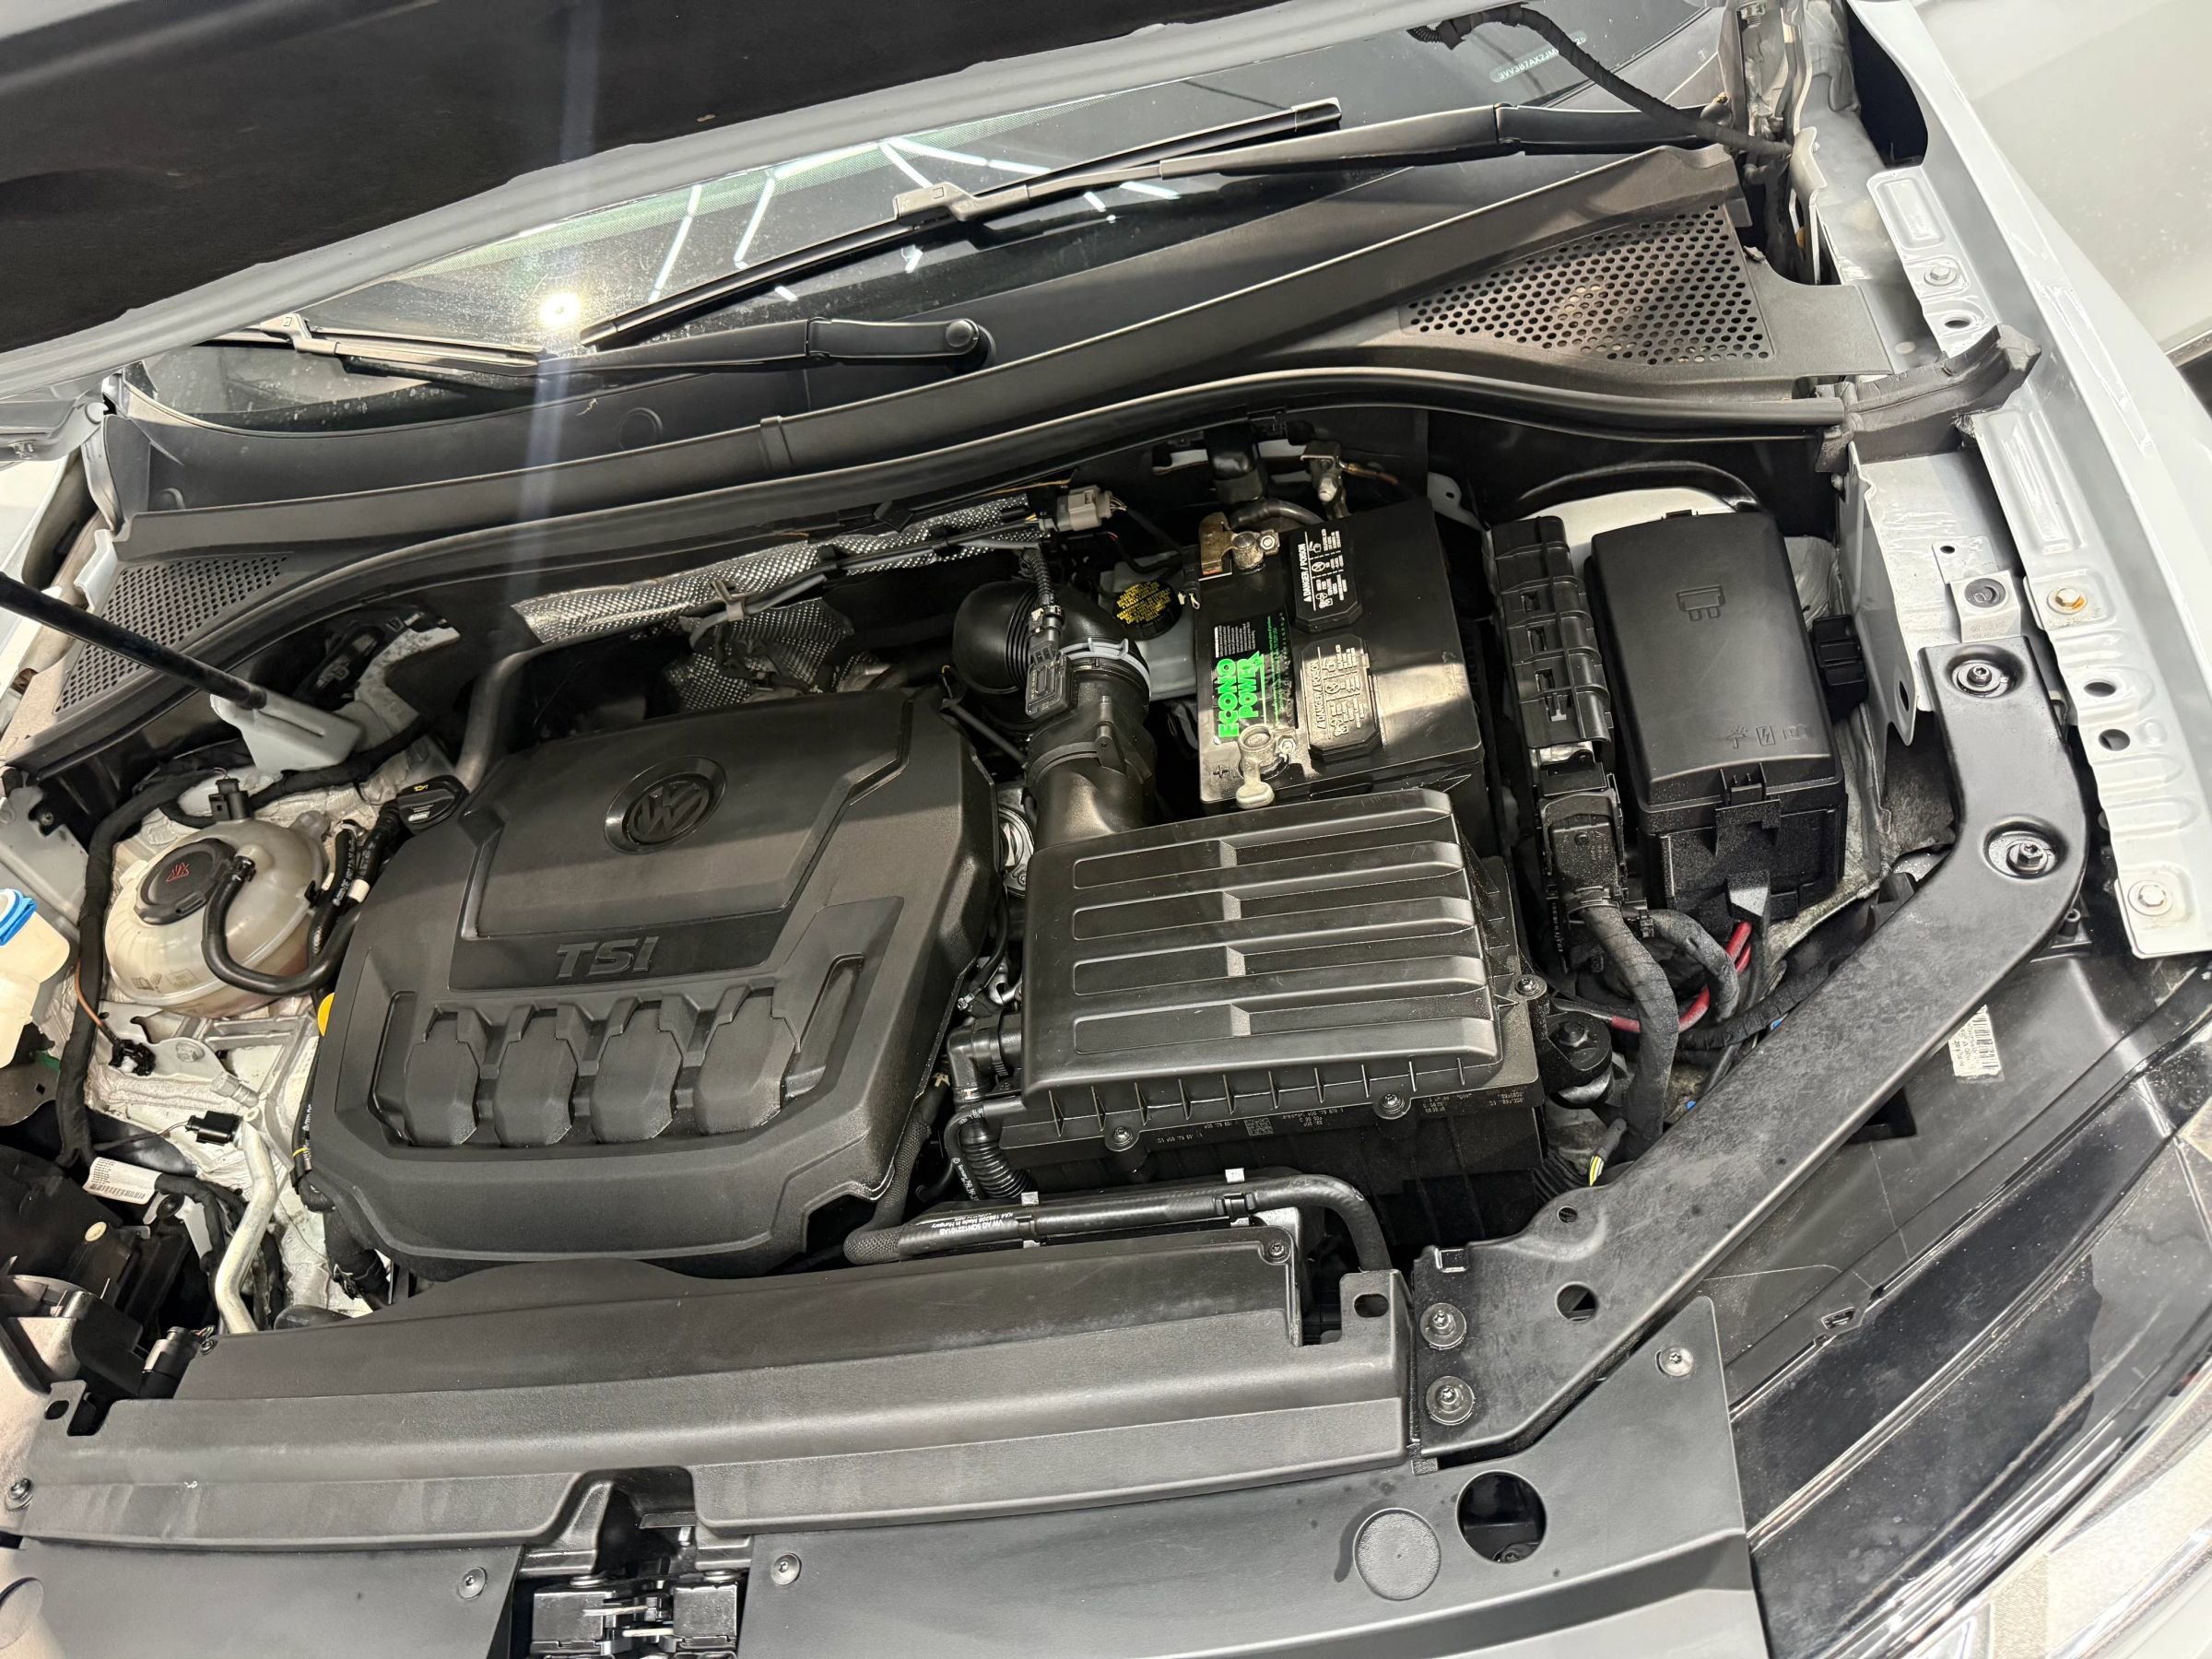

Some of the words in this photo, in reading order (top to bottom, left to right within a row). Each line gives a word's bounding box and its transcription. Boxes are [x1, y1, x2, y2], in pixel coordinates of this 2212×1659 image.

[1298, 543, 1308, 567] POISON
[1300, 571, 1312, 597] DANGER
[1217, 658, 1240, 738] ECONO
[1237, 651, 1259, 719] POWER
